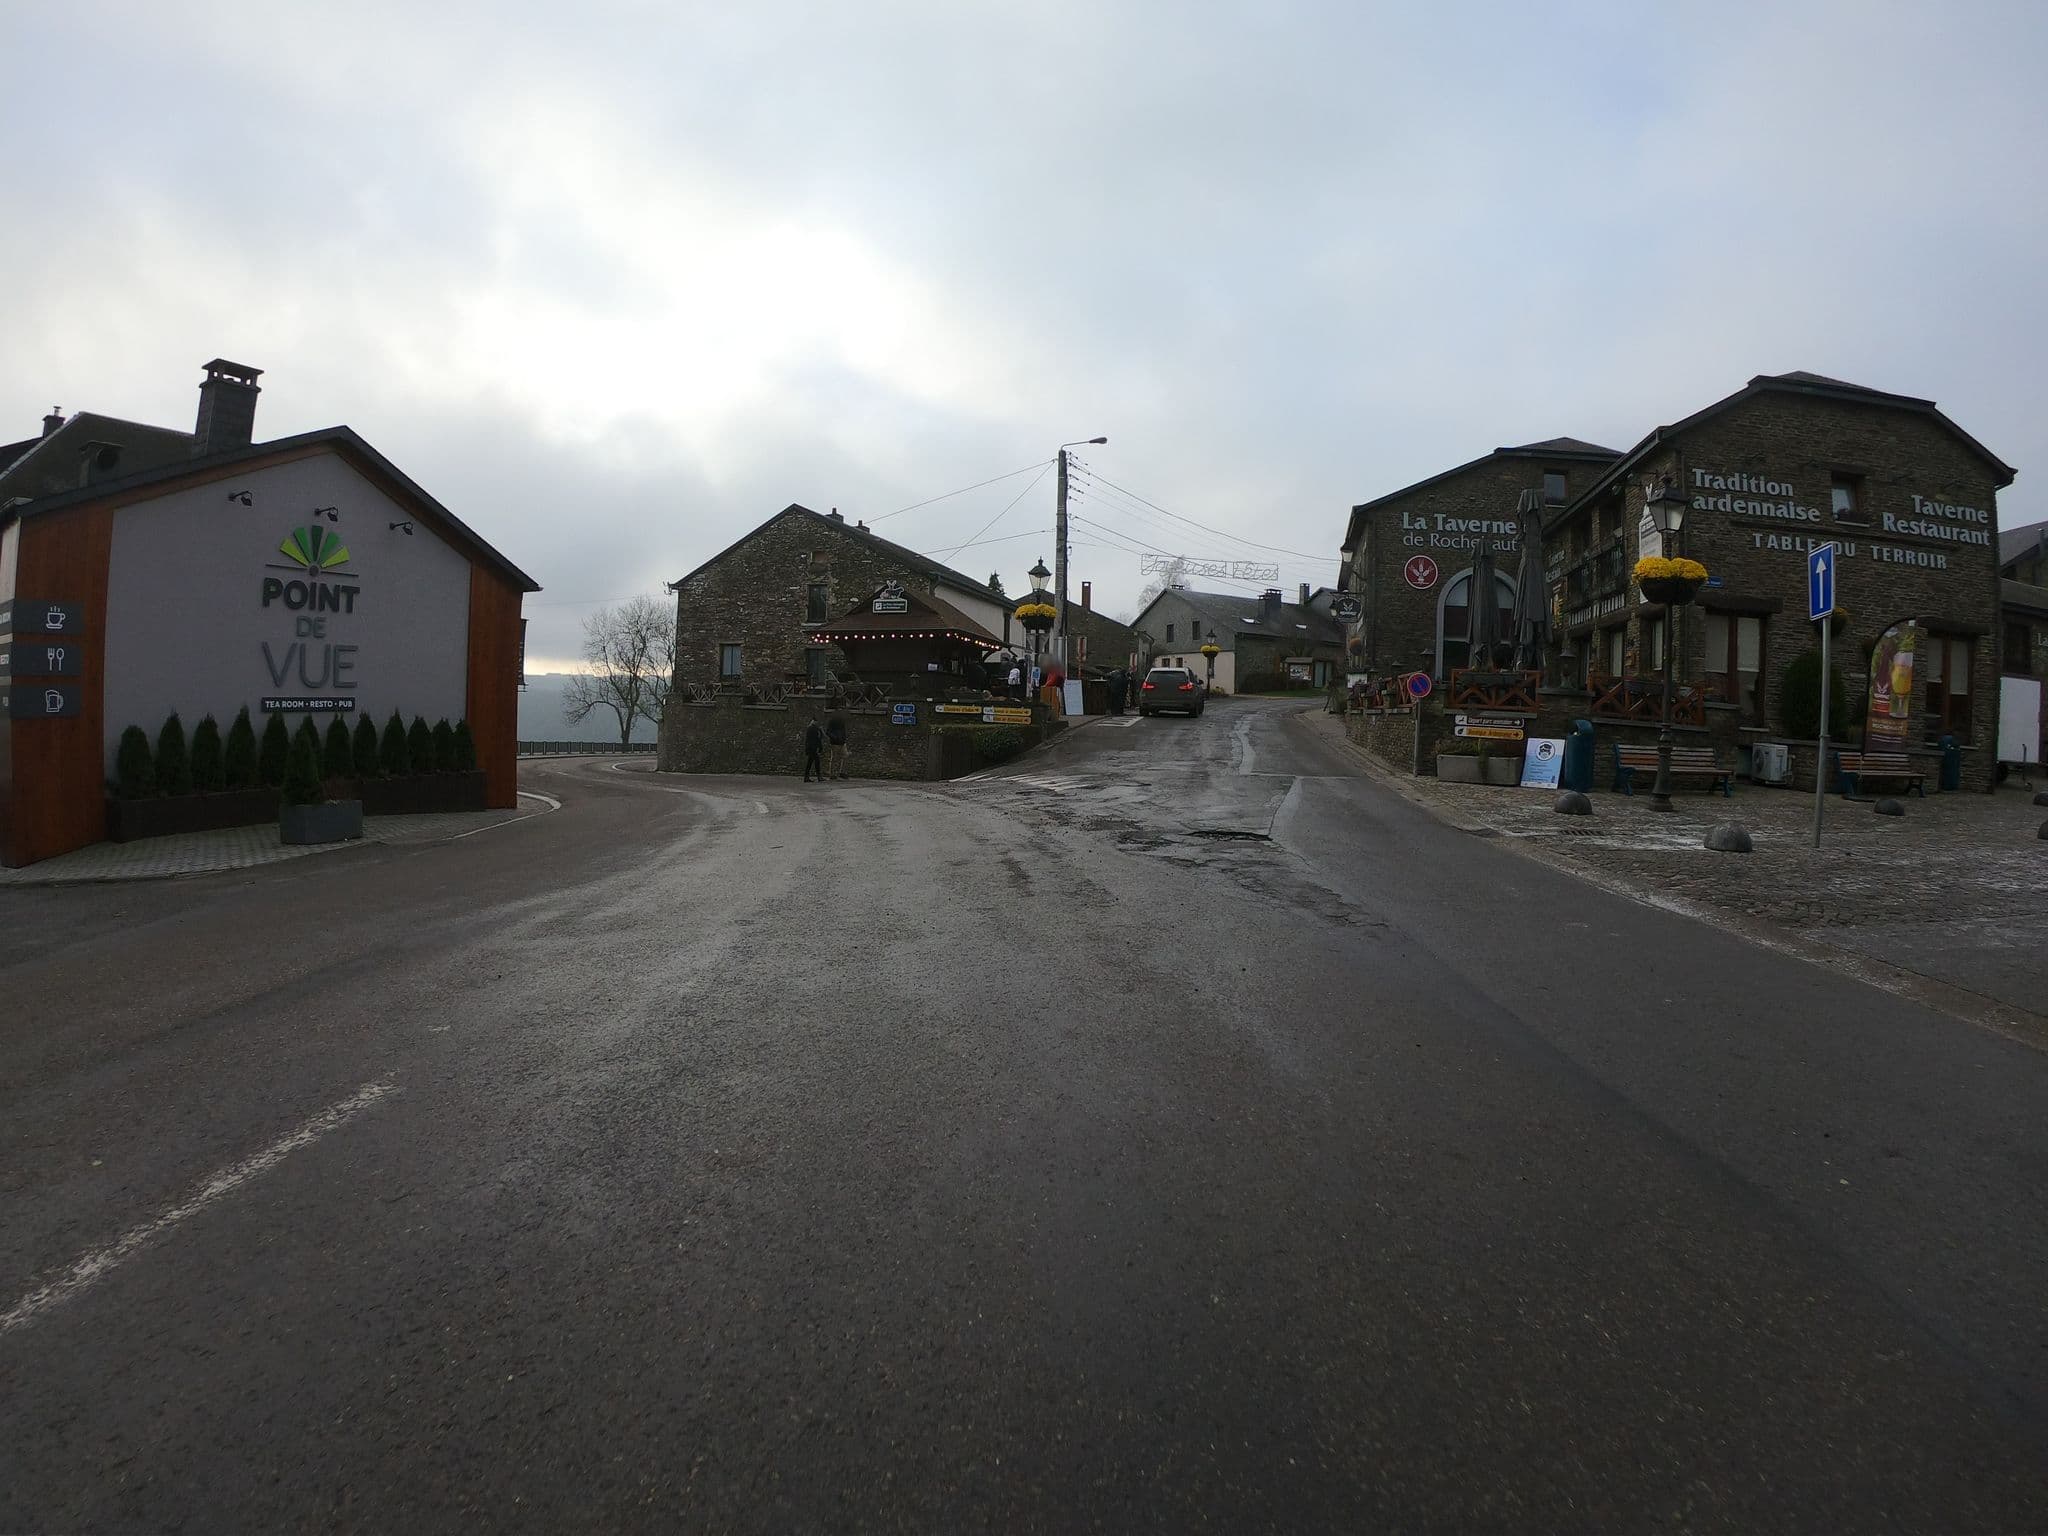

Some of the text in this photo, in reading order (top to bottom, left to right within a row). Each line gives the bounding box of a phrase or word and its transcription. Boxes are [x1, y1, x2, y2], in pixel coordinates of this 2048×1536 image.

[1691, 468, 1794, 497] Tradition
[1691, 494, 1821, 522] ardennaise
[1910, 494, 1989, 524] Taverne
[1402, 511, 1517, 534] La Taverne
[1882, 511, 1990, 546] Restaurant
[1402, 532, 1518, 551] de Rocheaut
[1870, 545, 1948, 570] TERROIR
[262, 577, 360, 613] POINT
[296, 615, 327, 638] DE
[261, 641, 358, 688] VUE
[265, 700, 280, 708] TEA
[282, 700, 304, 708] ROOM
